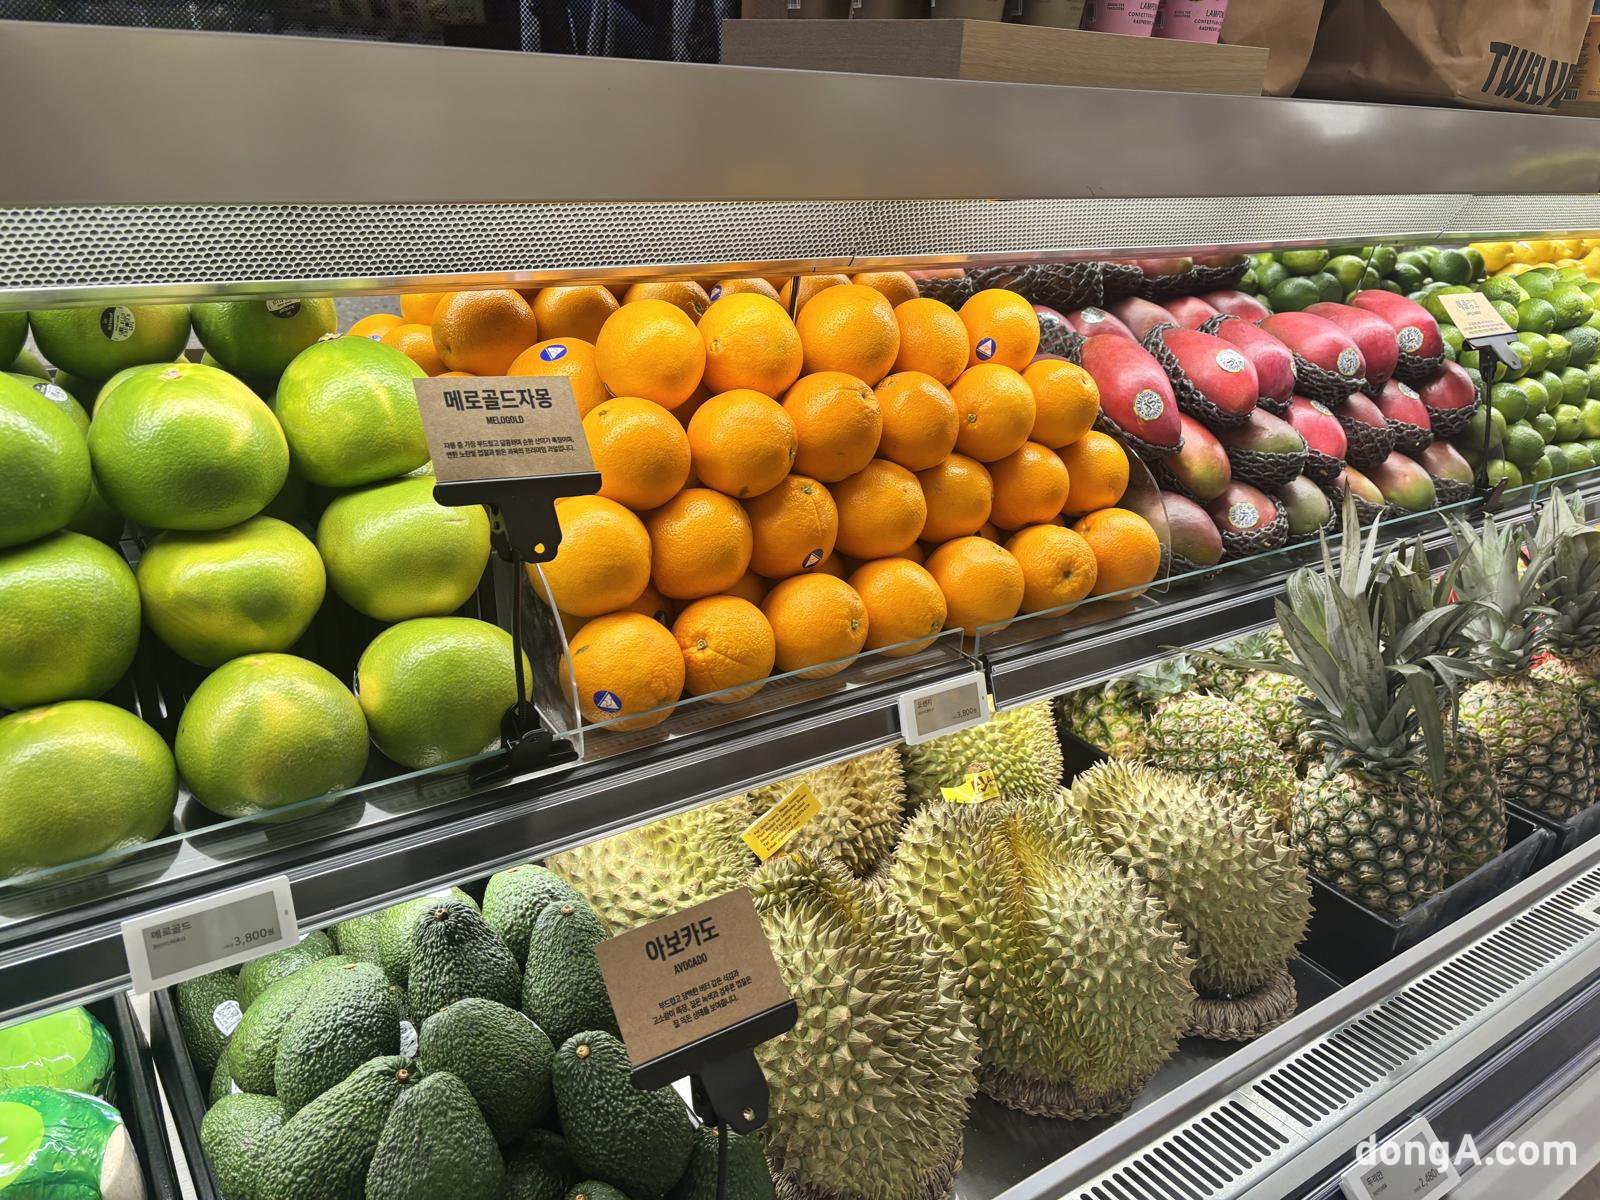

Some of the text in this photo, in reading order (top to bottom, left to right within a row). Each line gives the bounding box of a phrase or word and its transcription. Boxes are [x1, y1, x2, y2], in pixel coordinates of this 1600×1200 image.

[443, 388, 553, 412] 메로골드자몽
[486, 416, 524, 425] MELOGOLD
[645, 917, 720, 962] 아보카도
[673, 952, 708, 975] AVOCADO
